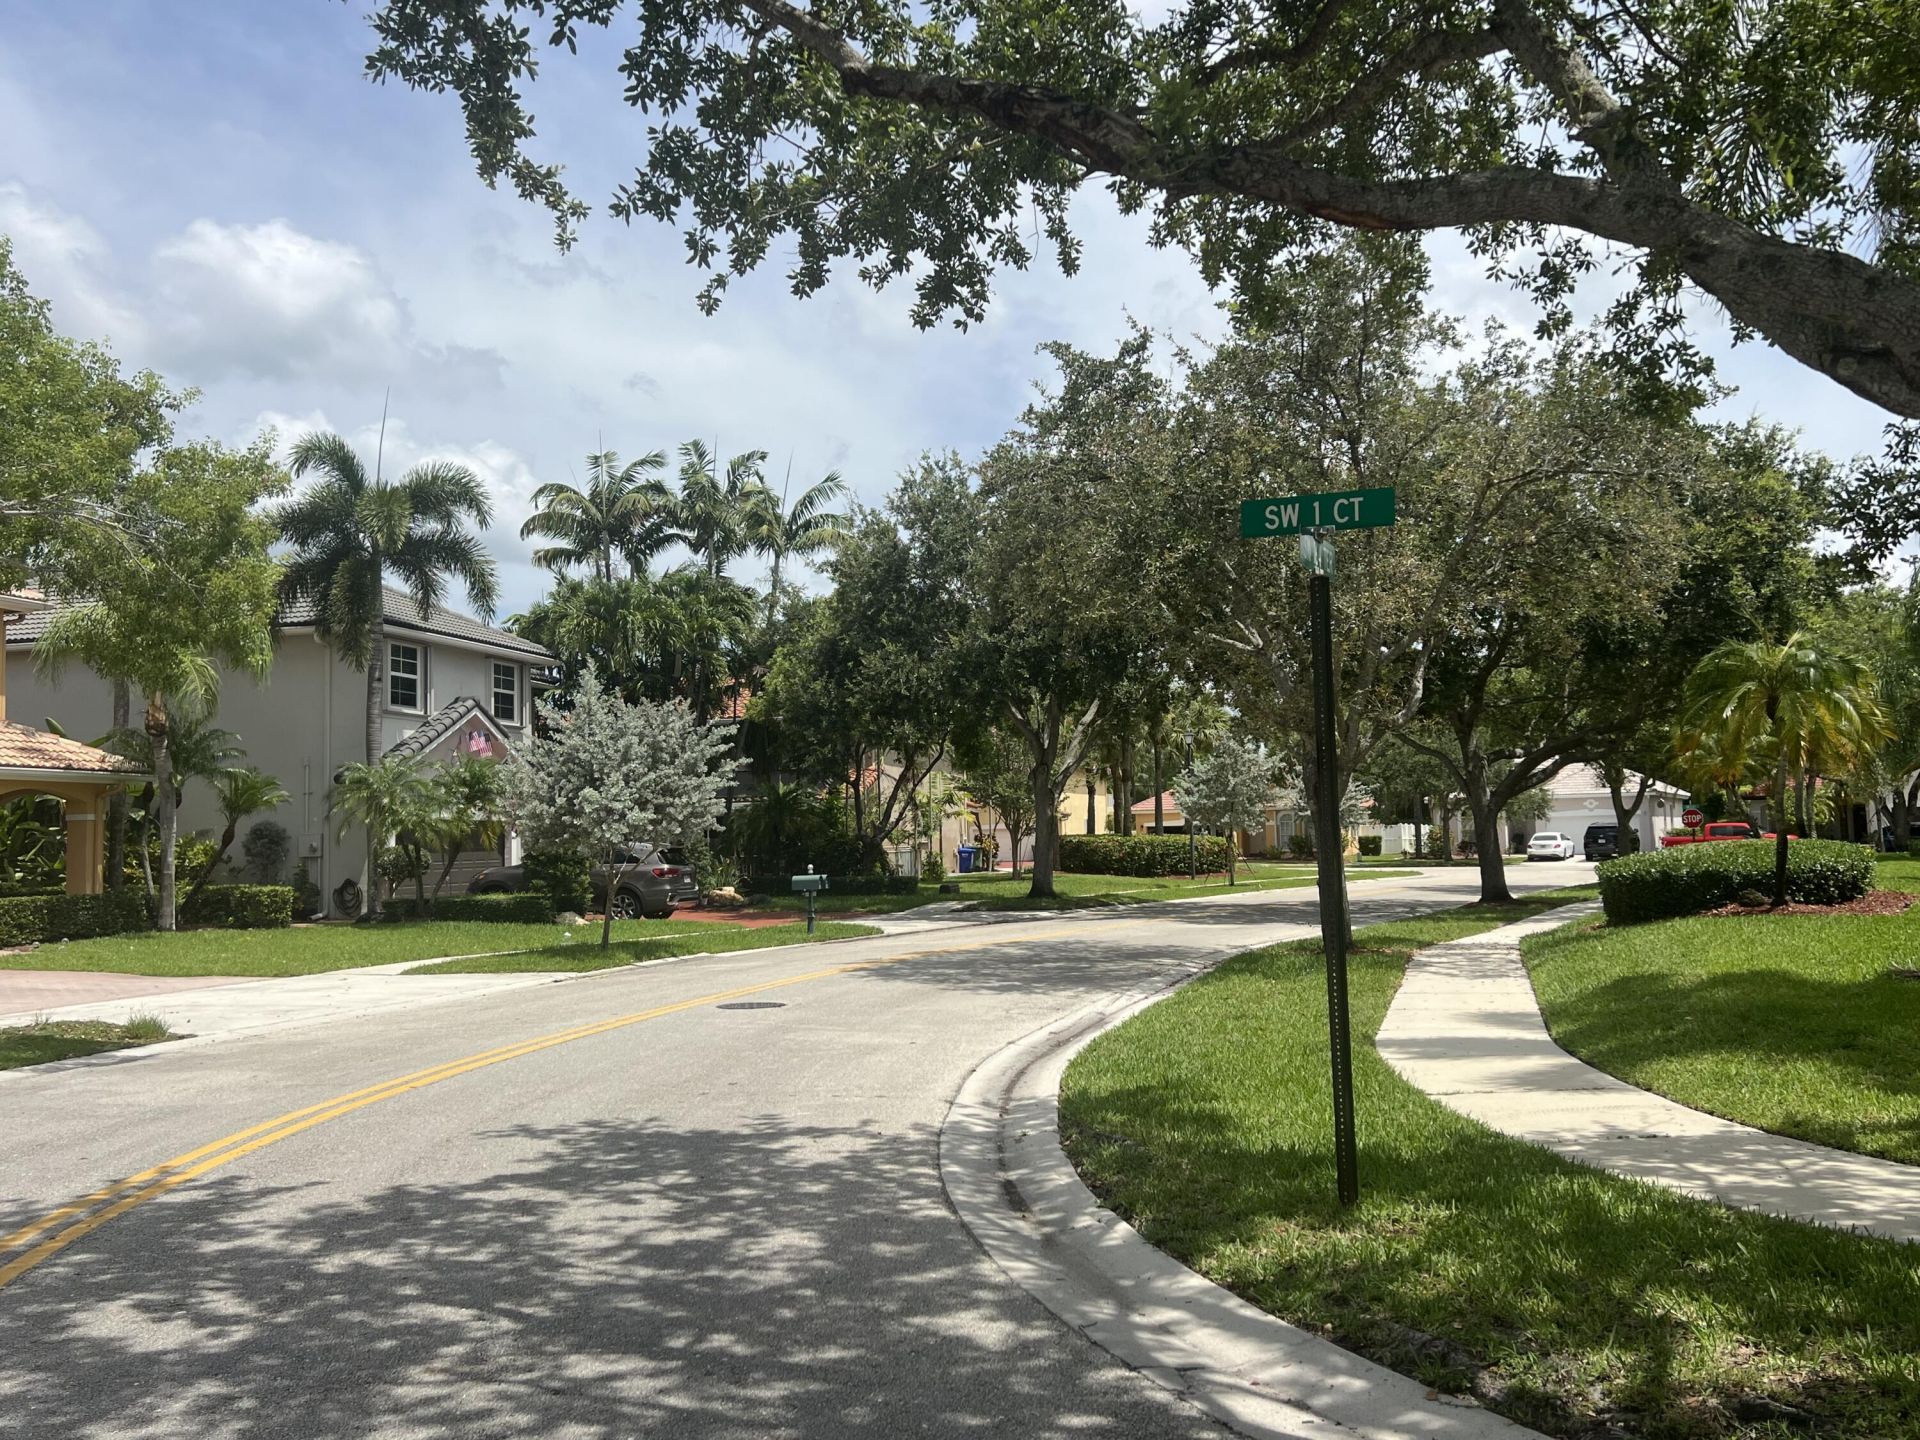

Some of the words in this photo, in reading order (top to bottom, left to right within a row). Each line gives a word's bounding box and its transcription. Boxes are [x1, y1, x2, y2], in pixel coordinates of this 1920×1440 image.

[1265, 503, 1299, 530] SW
[1312, 501, 1320, 525] 1
[1333, 497, 1364, 523] CT
[1683, 815, 1701, 823] STOP
